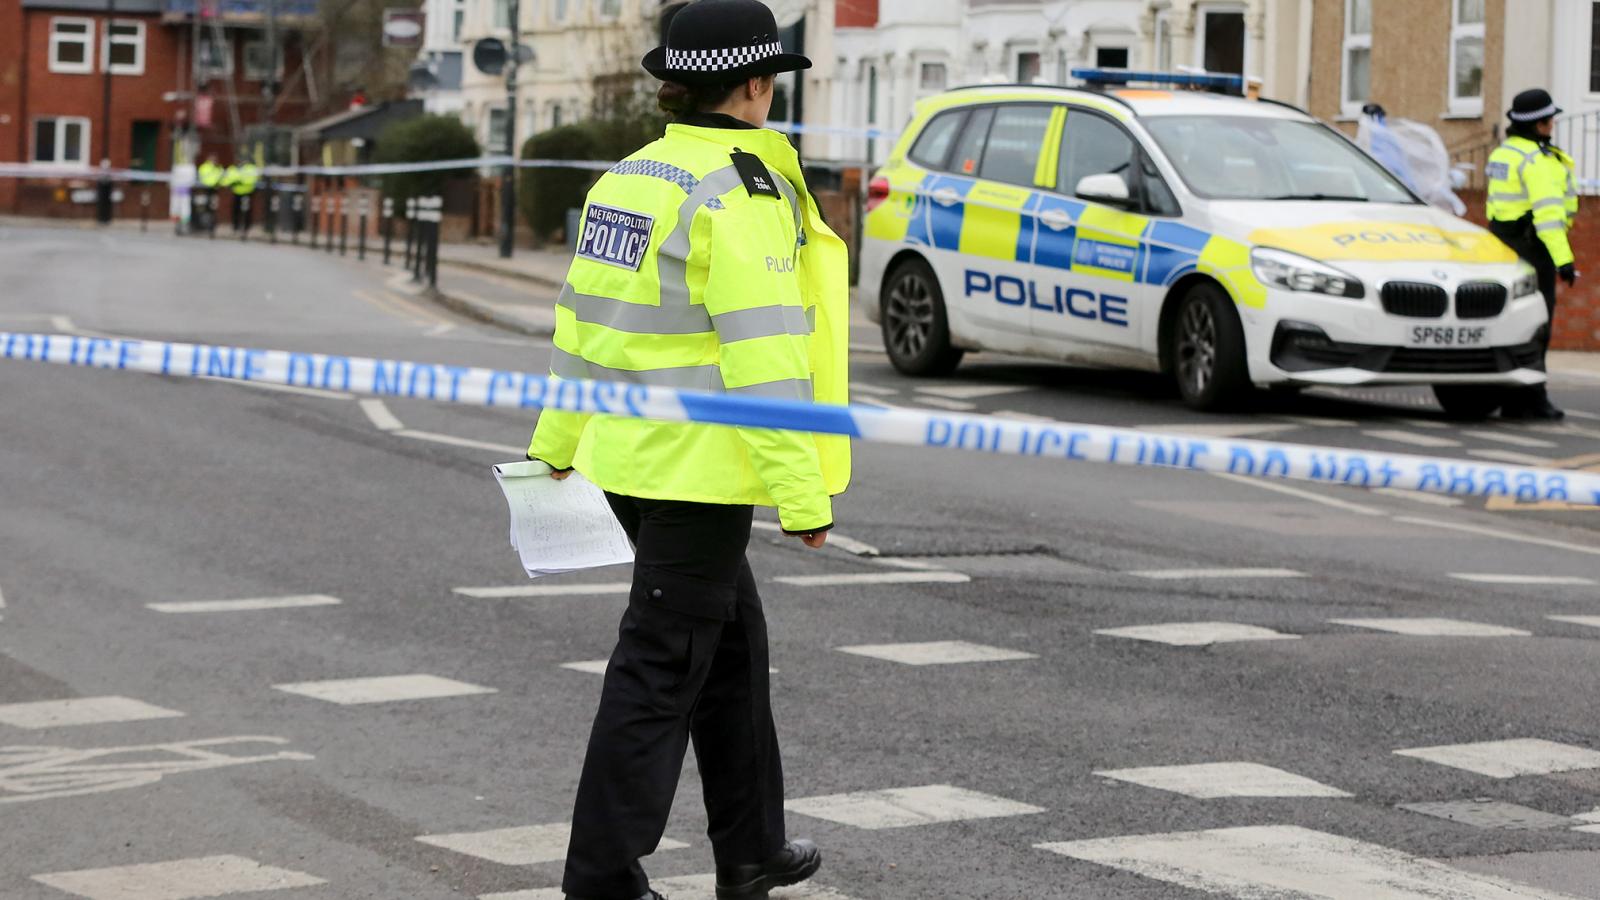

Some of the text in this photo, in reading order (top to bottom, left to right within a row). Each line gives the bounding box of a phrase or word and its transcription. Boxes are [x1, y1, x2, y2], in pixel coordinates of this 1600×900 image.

[588, 207, 651, 231] METROPOLITAN
[580, 221, 648, 265] POLICE
[963, 269, 1129, 327] POLICE
[1412, 325, 1455, 345] SP68
[285, 351, 351, 390] DO
[373, 359, 471, 402] NOT
[485, 369, 650, 418] CROSS
[924, 417, 1090, 462] POLICE
